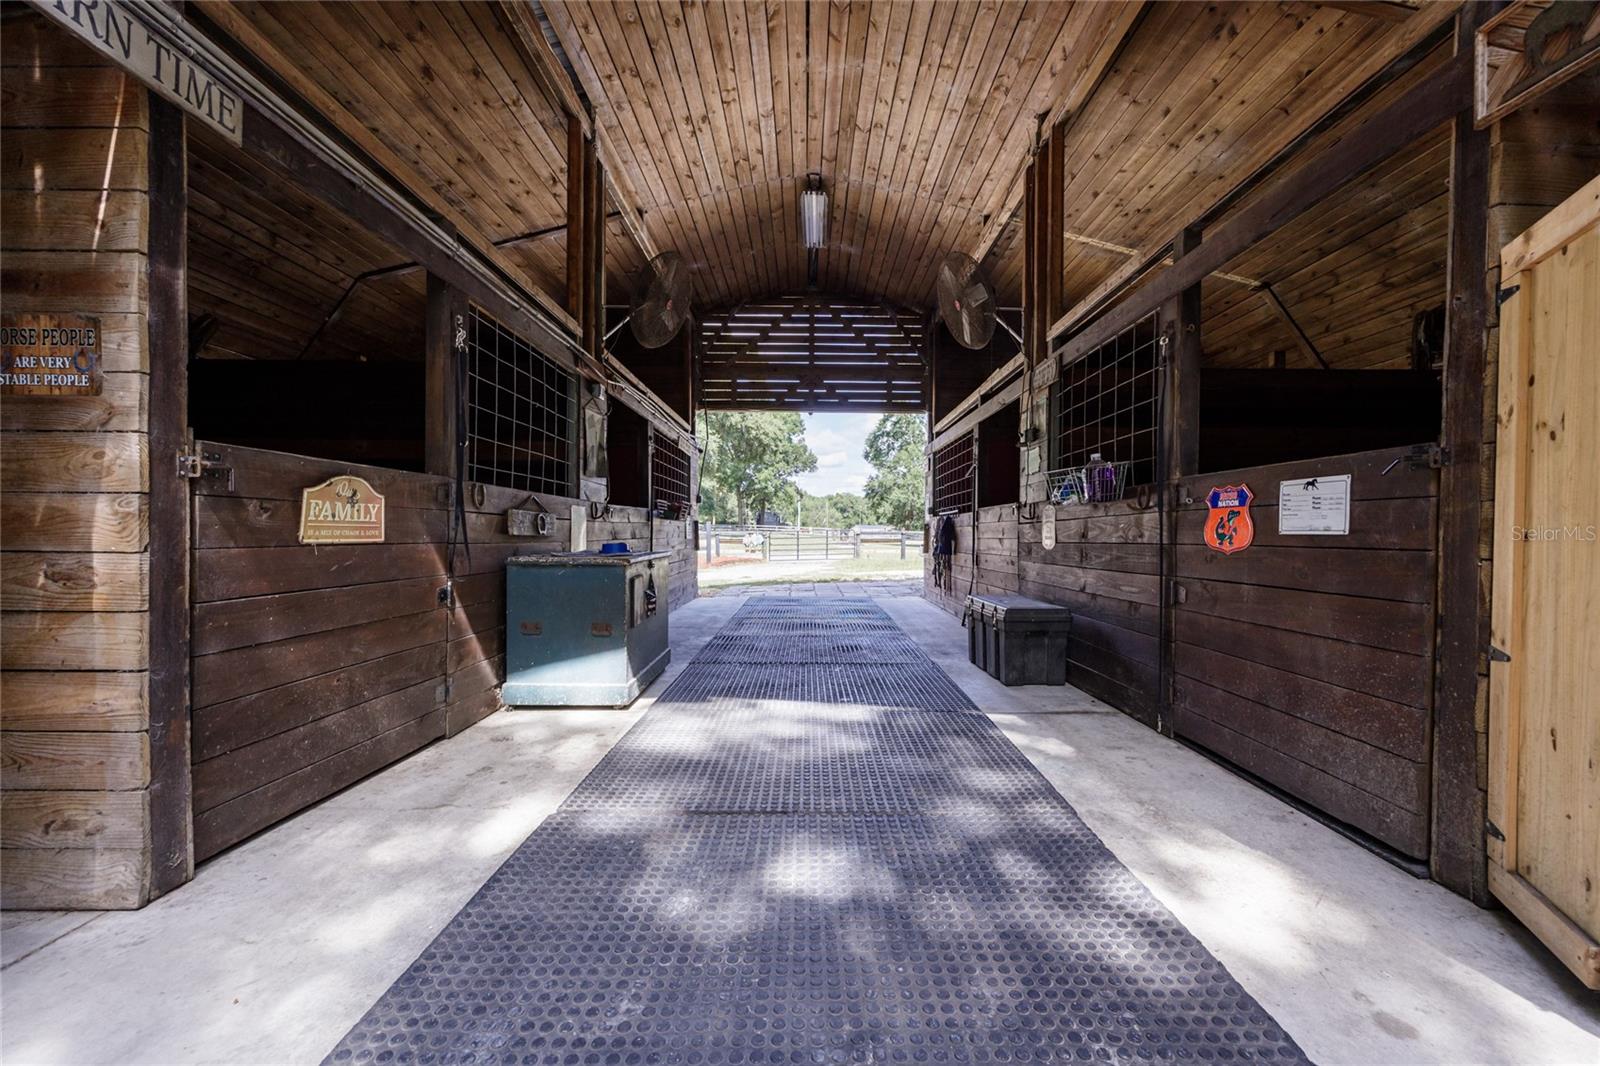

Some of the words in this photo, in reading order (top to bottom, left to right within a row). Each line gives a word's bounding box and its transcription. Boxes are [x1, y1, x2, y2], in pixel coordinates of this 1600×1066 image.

[147, 32, 237, 135] TIME
[41, 328, 96, 347] PEOPLE
[13, 356, 38, 369] ARE
[39, 356, 72, 369] VERY
[0, 373, 41, 386] STABLE
[43, 374, 90, 387] PEOPLE
[307, 499, 381, 523] FAMILY
